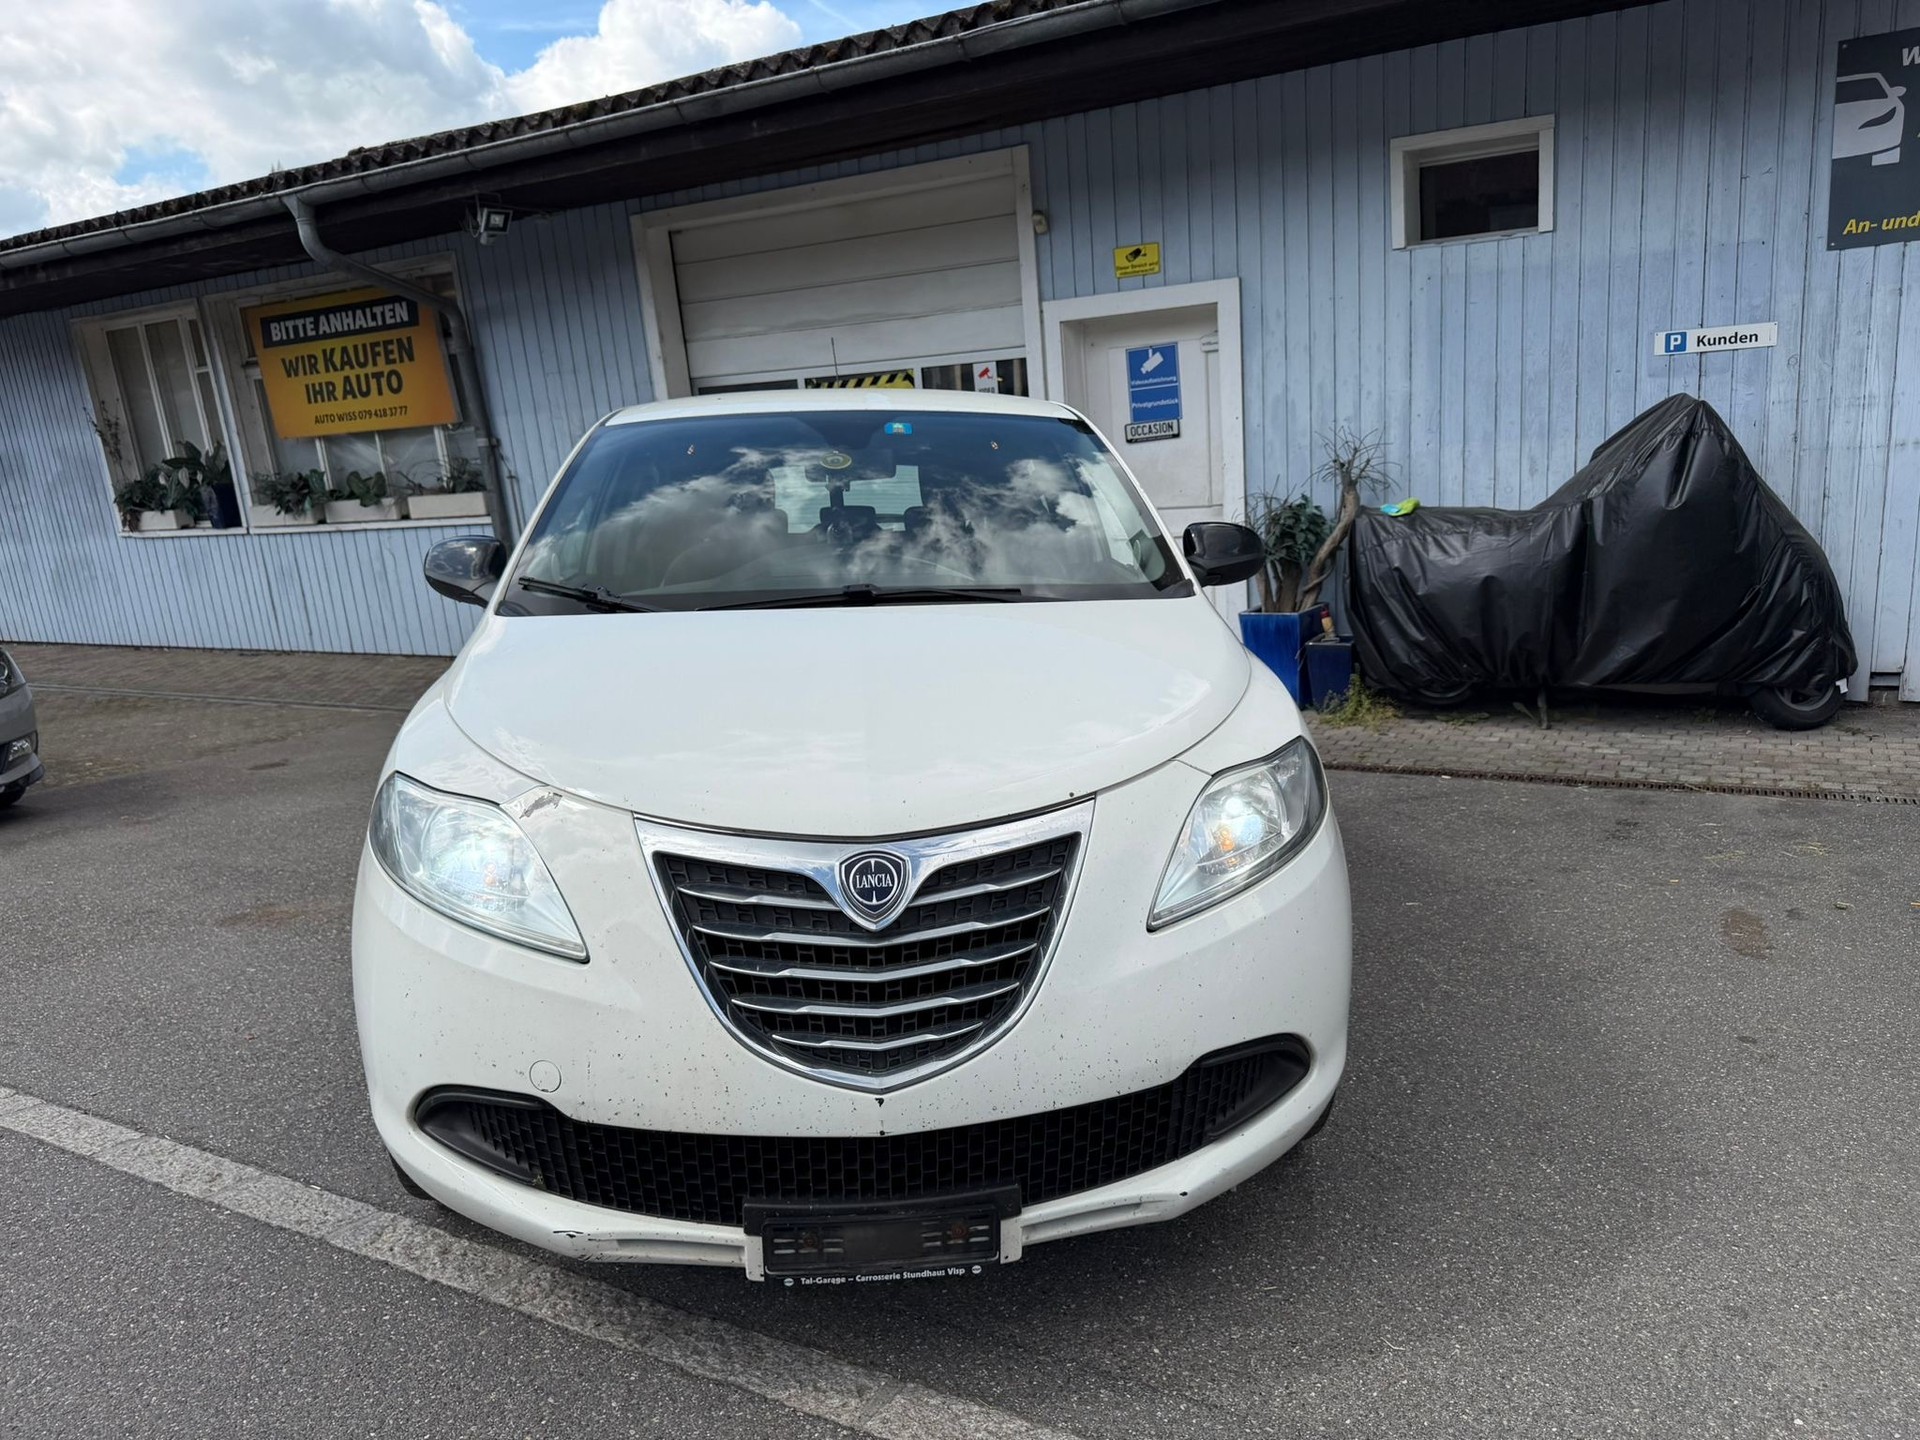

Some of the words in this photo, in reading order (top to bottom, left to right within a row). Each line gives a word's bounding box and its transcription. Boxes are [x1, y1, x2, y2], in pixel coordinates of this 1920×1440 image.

[1842, 218, 1878, 236] An-
[269, 316, 317, 342] BITTE
[318, 300, 410, 336] ANHALTEN
[1696, 331, 1759, 348] Kunden
[280, 353, 321, 379] WIR
[321, 335, 416, 374] KAUFEN
[304, 380, 339, 405] IHR
[341, 368, 404, 401] AUTO
[314, 412, 336, 425] AUTO
[336, 410, 358, 423] WISS
[358, 408, 373, 421] 079
[373, 407, 388, 419] 418
[1129, 421, 1175, 438] OCCASION
[855, 872, 893, 889] LANCIA
[800, 1276, 847, 1286] Tal-Garage
[855, 1272, 901, 1283] Carrosserie
[902, 1268, 946, 1280] Stundhaus
[947, 1266, 966, 1277] Visp
